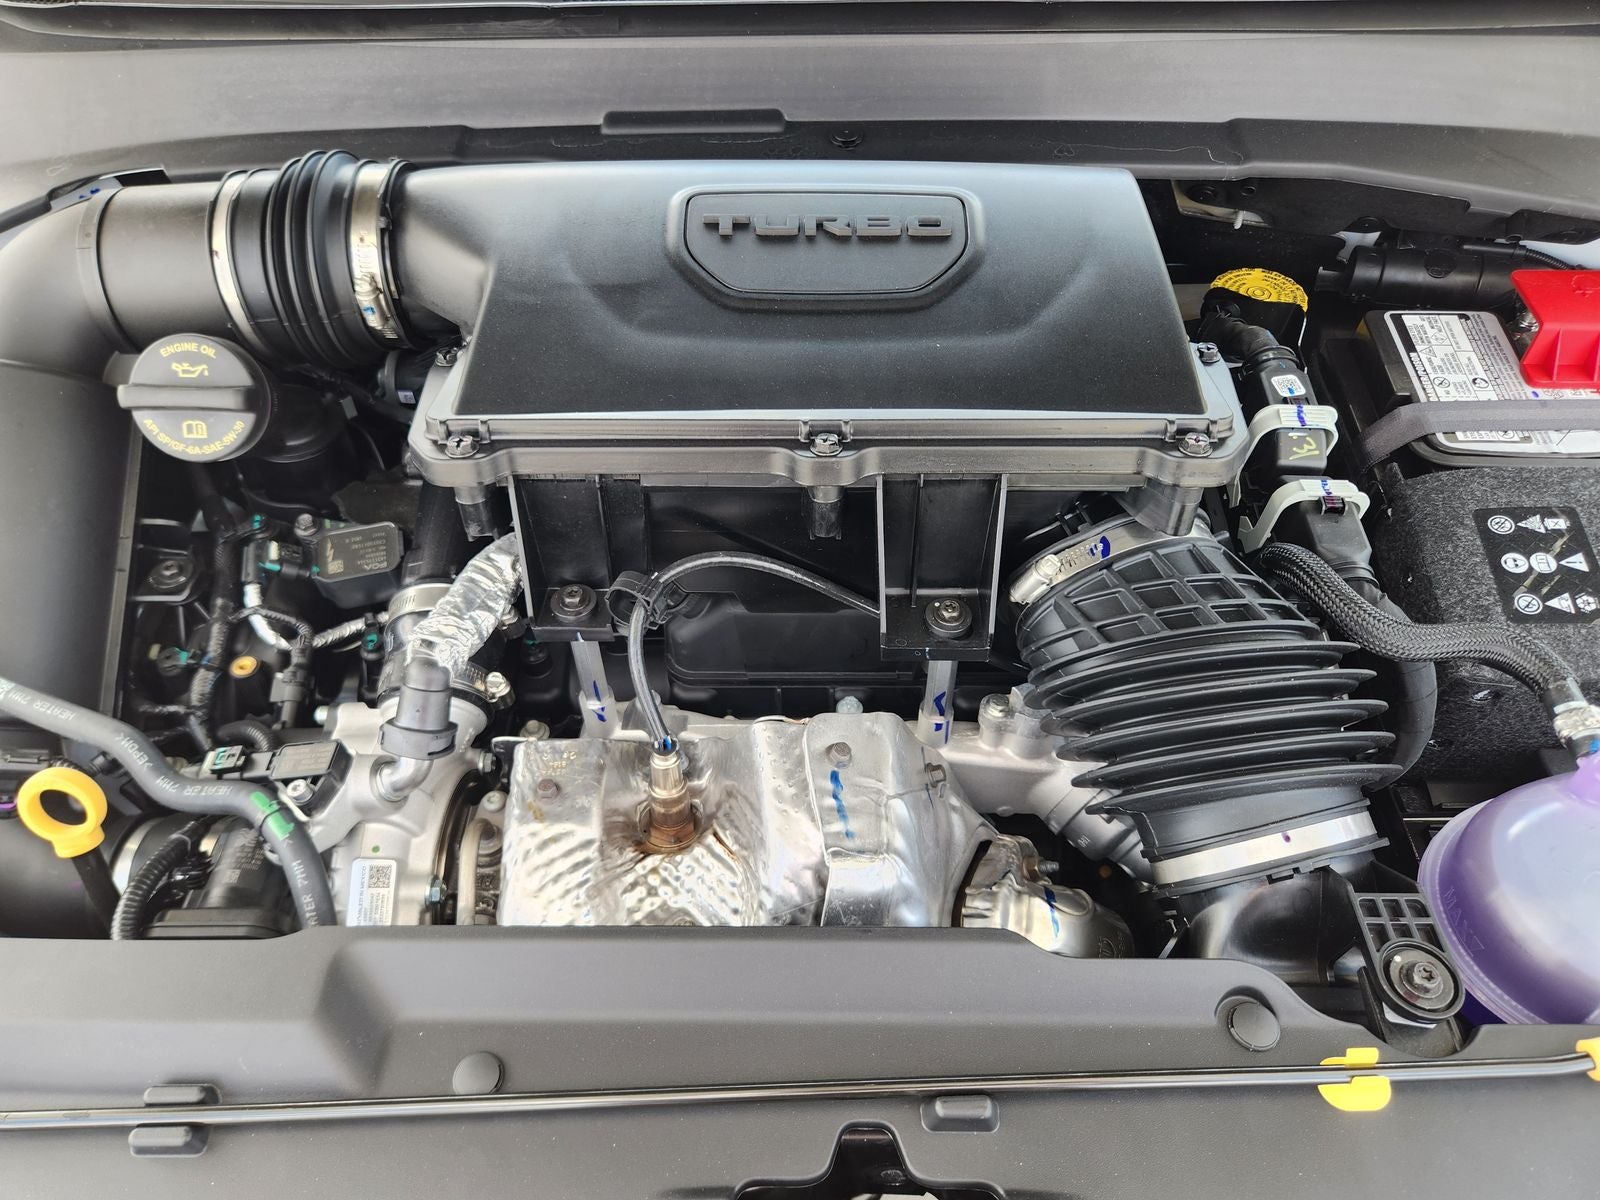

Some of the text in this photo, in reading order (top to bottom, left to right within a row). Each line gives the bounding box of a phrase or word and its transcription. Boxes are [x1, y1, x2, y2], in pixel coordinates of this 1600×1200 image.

[703, 213, 952, 237] TURBO
[160, 342, 217, 359] ENGINE OIL
[143, 419, 159, 435] API
[33, 701, 76, 720] HEATER
[183, 785, 233, 796] HEATER
